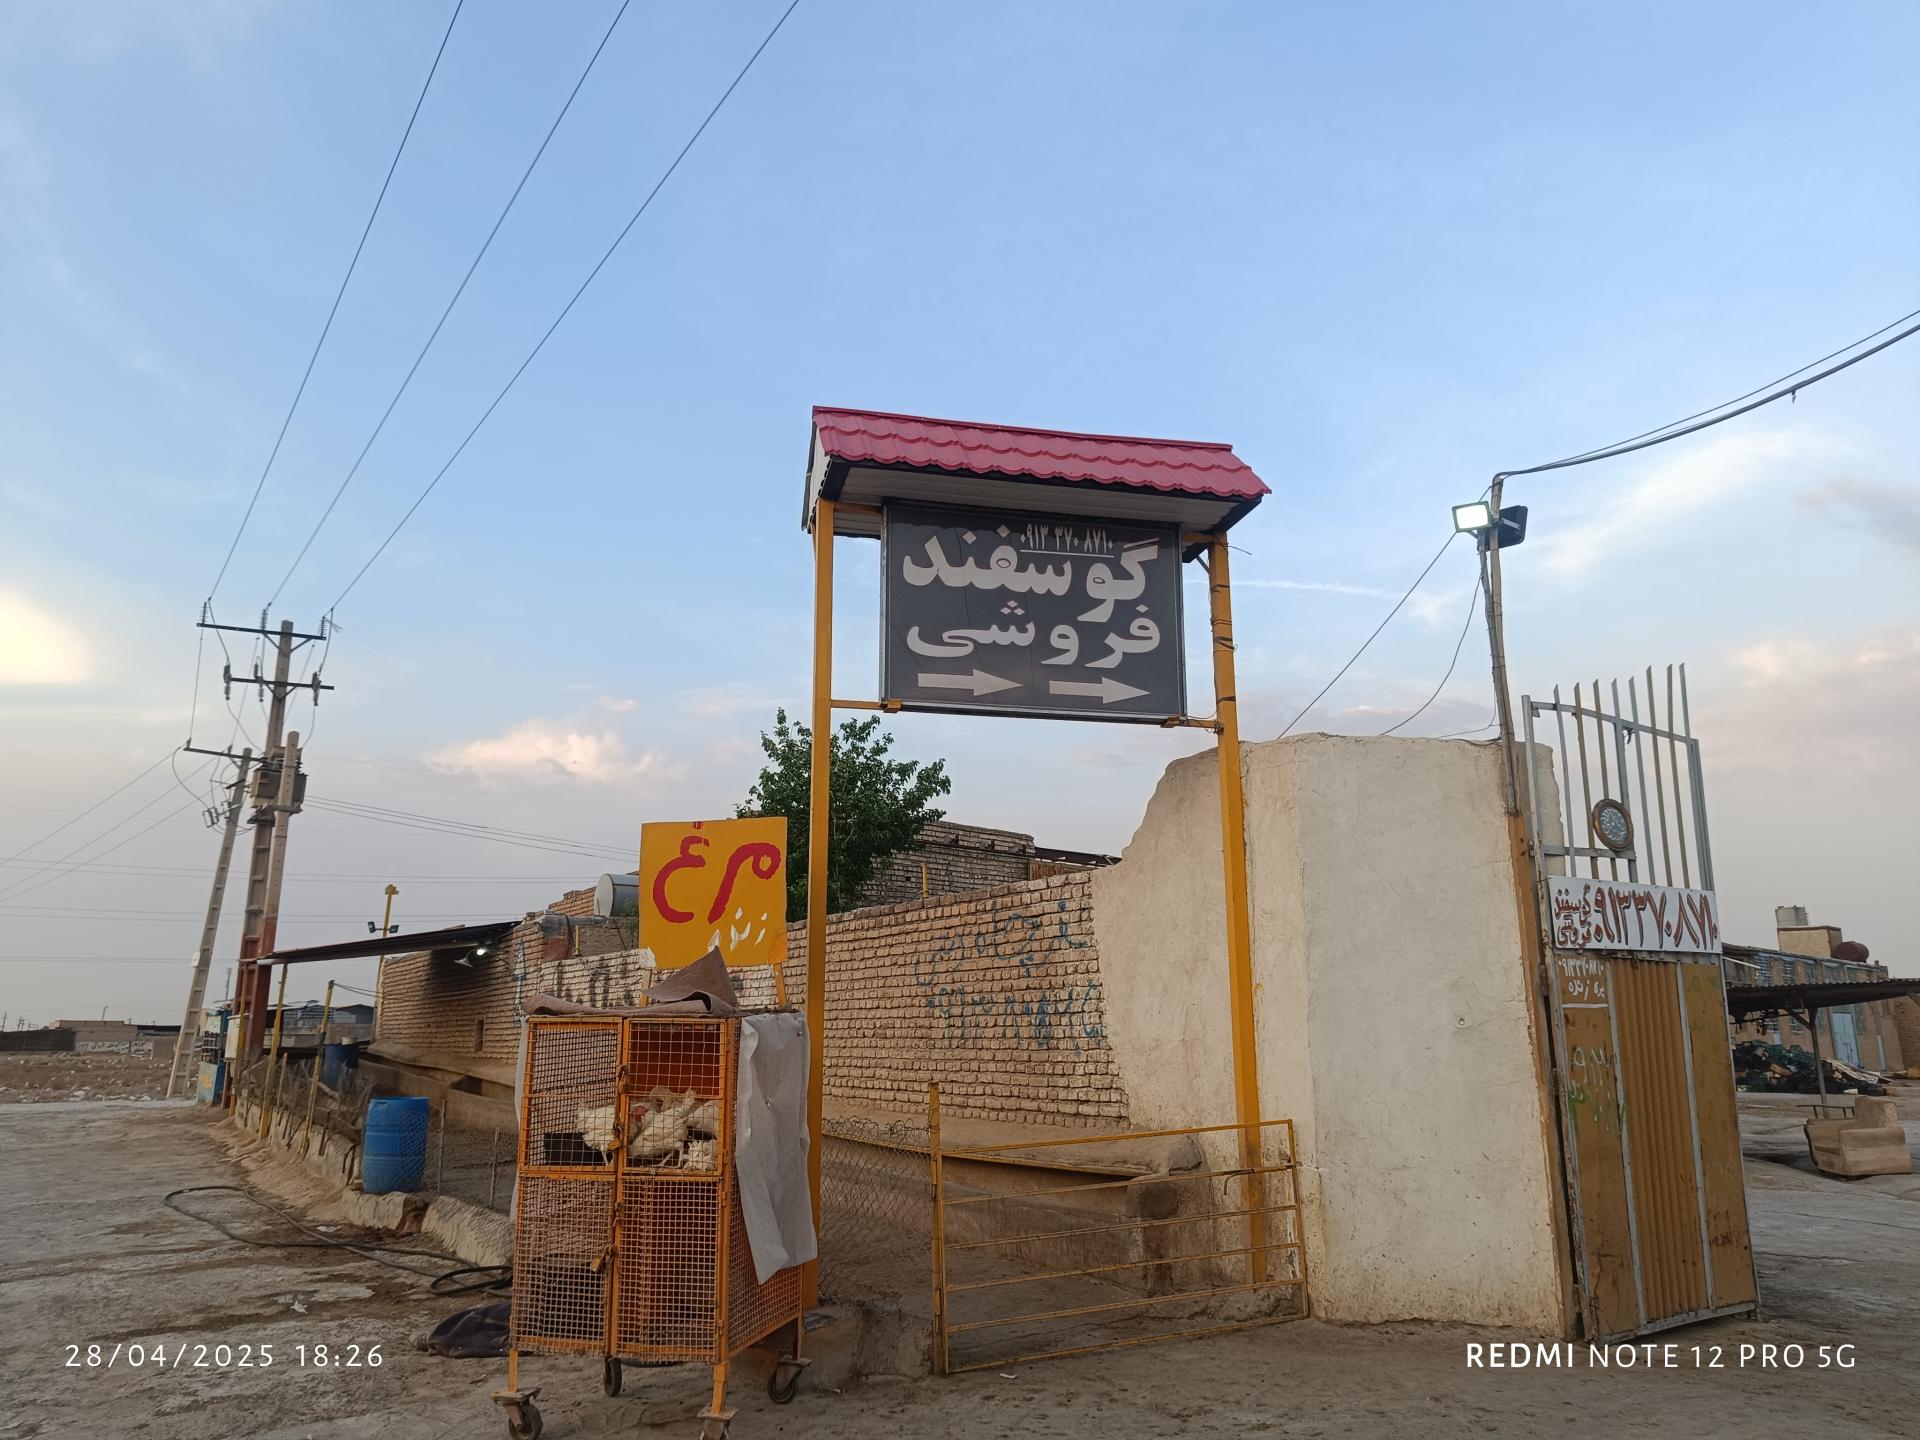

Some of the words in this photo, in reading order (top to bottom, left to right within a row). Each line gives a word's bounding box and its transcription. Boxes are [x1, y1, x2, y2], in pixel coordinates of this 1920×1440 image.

[903, 524, 1159, 622] گوسفند
[907, 601, 1161, 668] فروشی
[652, 821, 781, 925] مرغ
[1594, 886, 1718, 950] ۰۹۱۳۳۷۰۸۷۱۰
